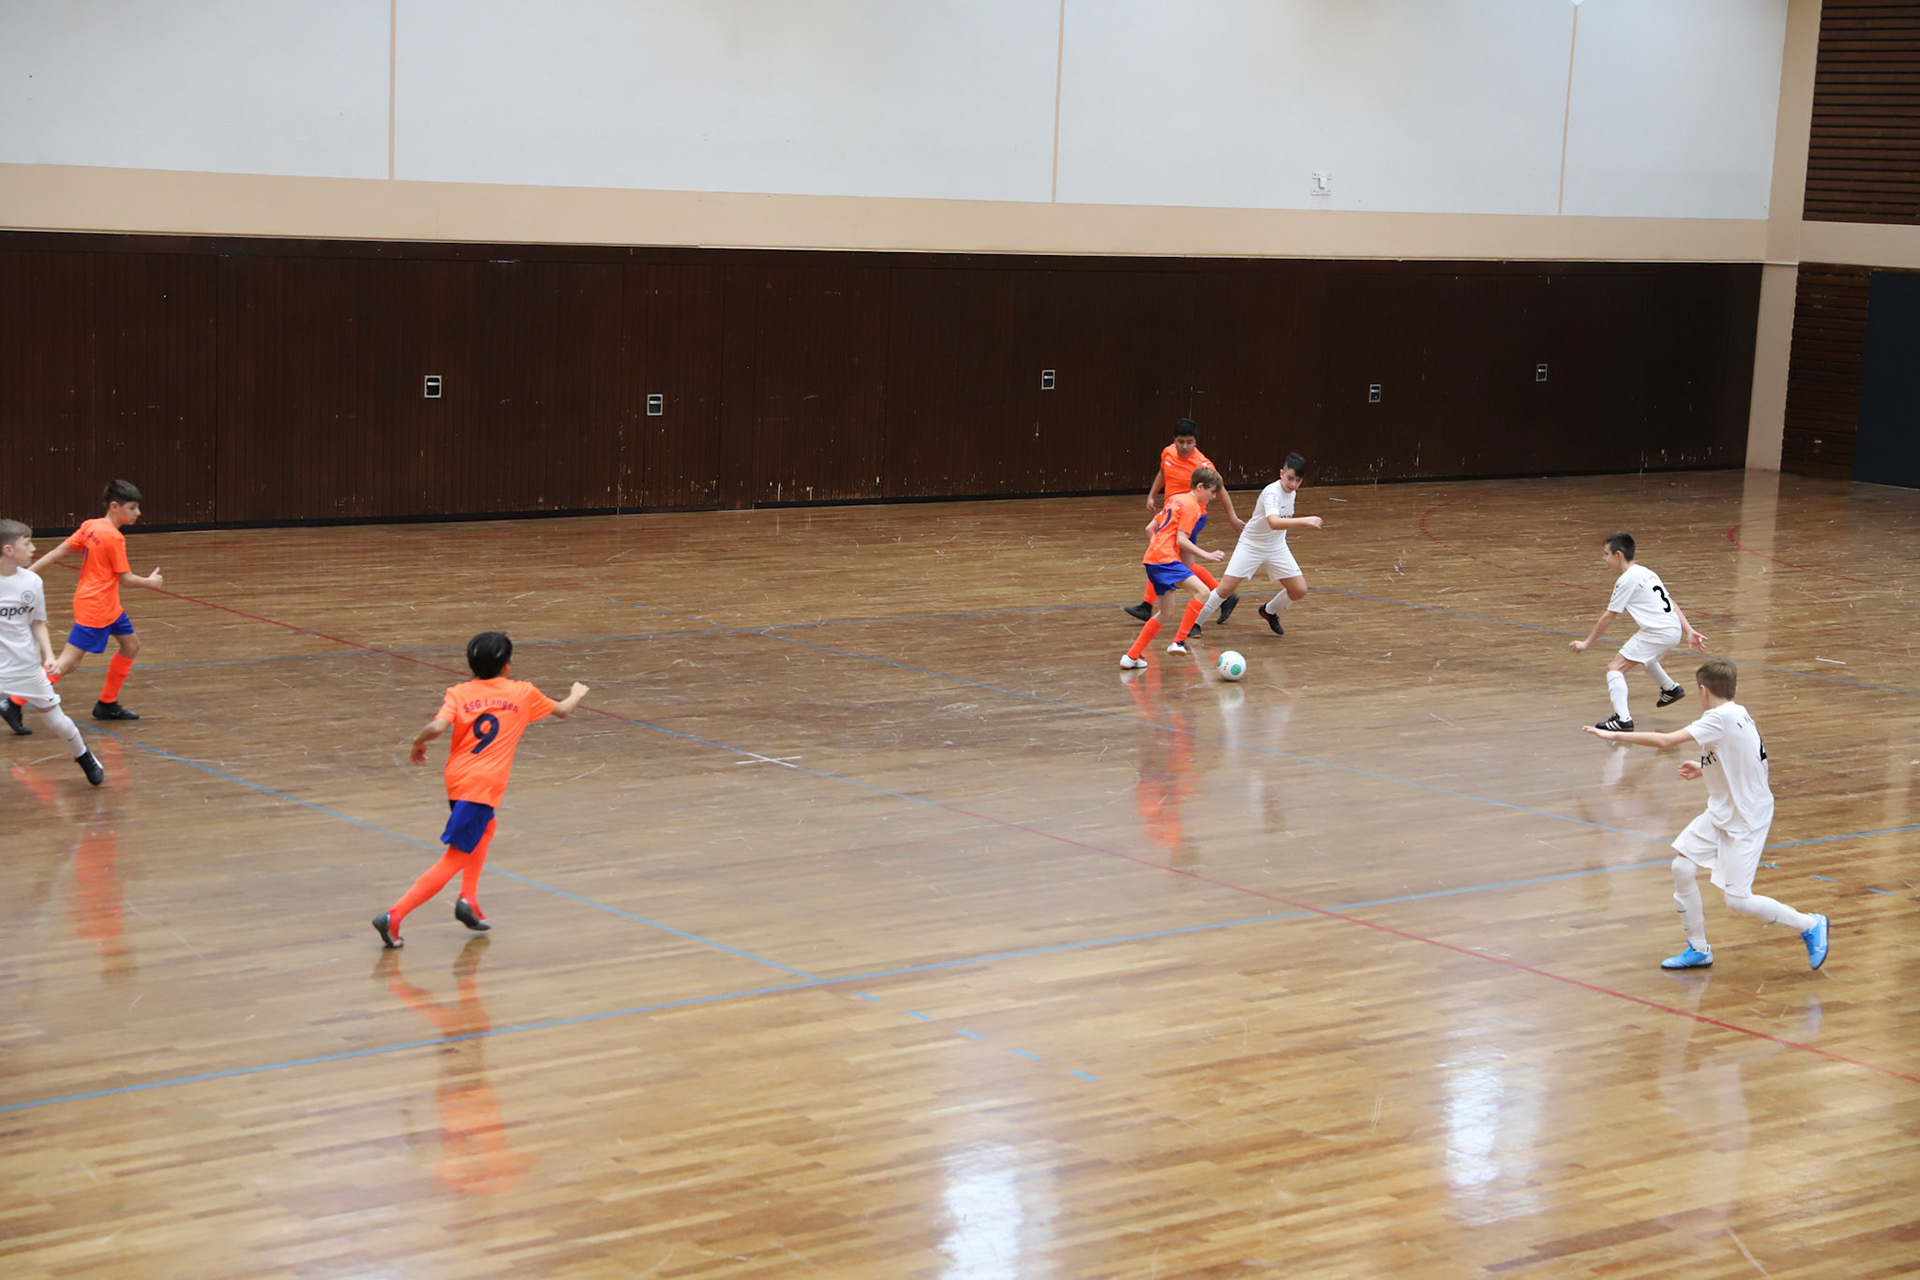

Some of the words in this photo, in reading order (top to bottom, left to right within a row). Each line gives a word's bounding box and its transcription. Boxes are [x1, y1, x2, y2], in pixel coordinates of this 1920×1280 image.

[1652, 585, 1671, 613] 3
[463, 699, 482, 713] SSG
[484, 698, 519, 713] Langen
[470, 712, 499, 755] 9
